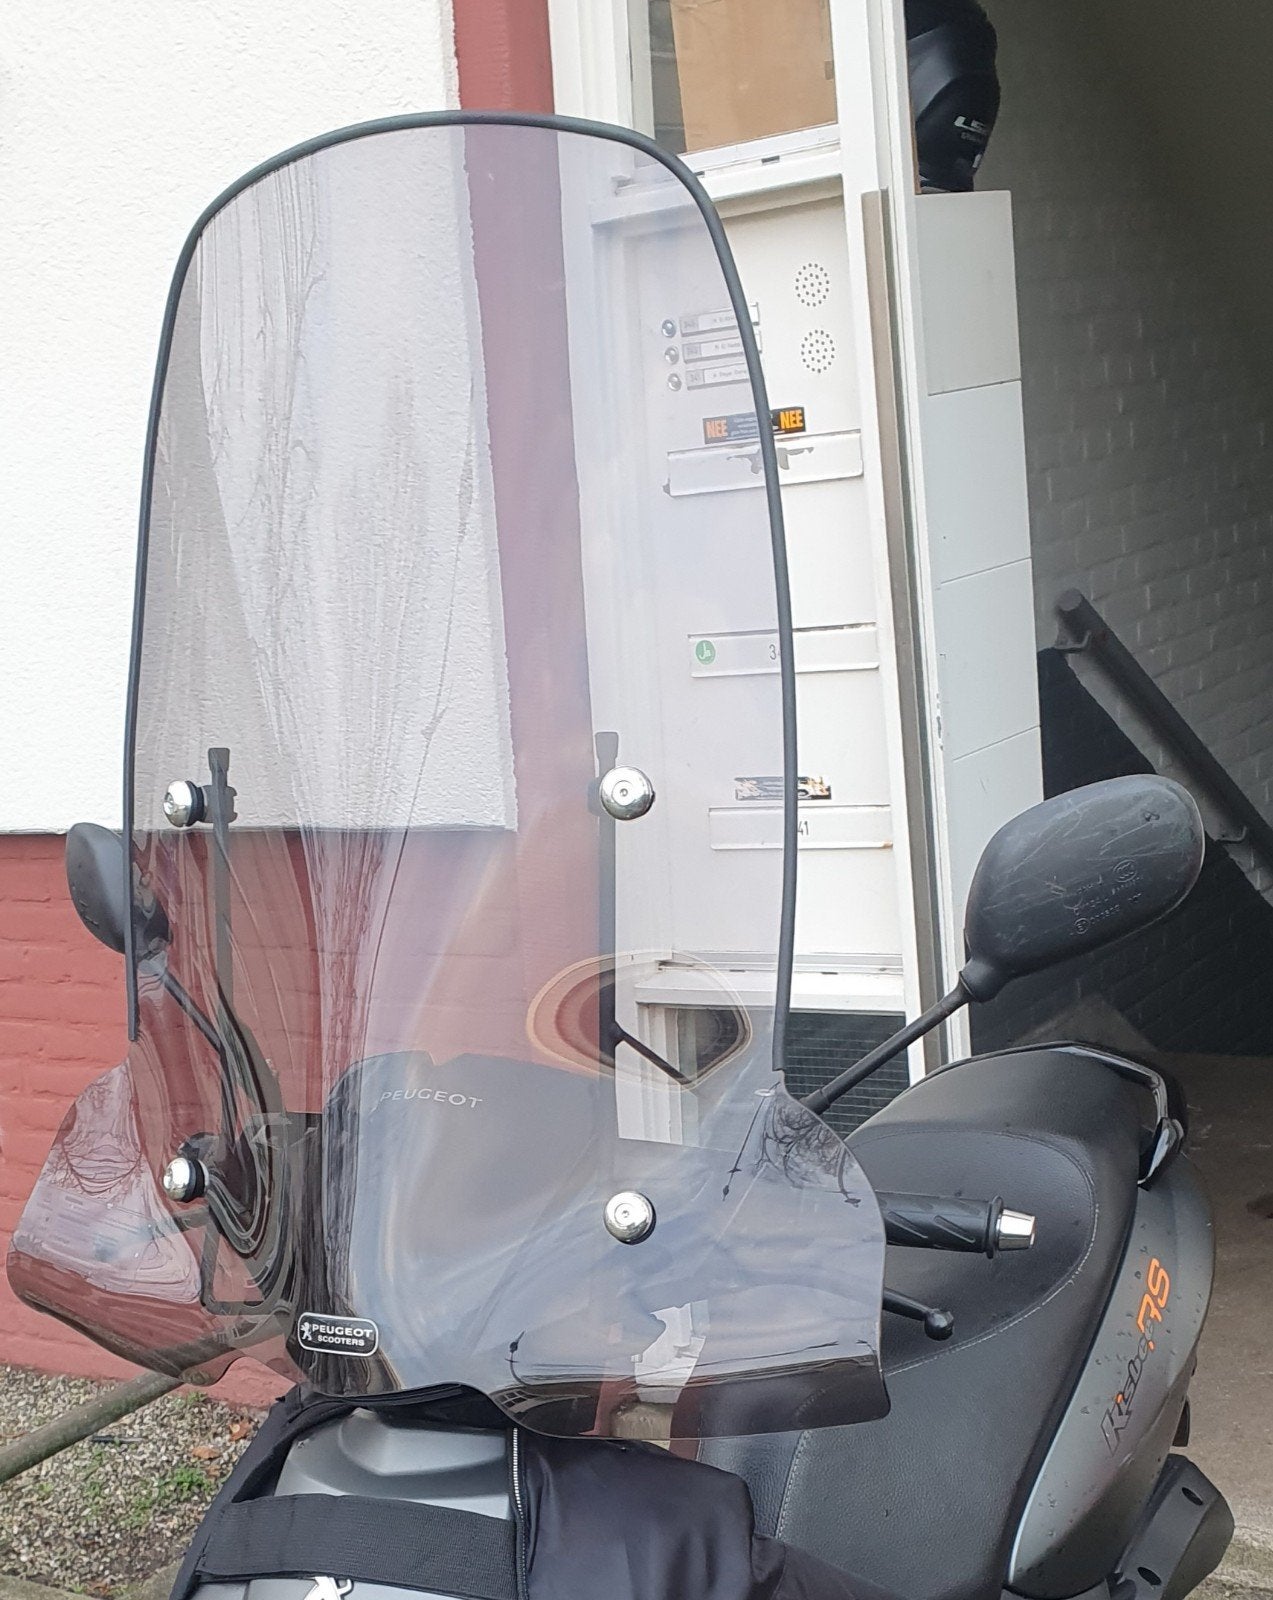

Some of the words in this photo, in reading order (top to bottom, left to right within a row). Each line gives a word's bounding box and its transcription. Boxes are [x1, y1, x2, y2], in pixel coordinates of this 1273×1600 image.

[705, 419, 728, 438] NEE
[781, 409, 804, 430] NEE
[380, 1087, 484, 1109] PEUGEOT
[312, 1323, 374, 1338] PEUGEOT
[317, 1335, 366, 1347] SCOOTERS
